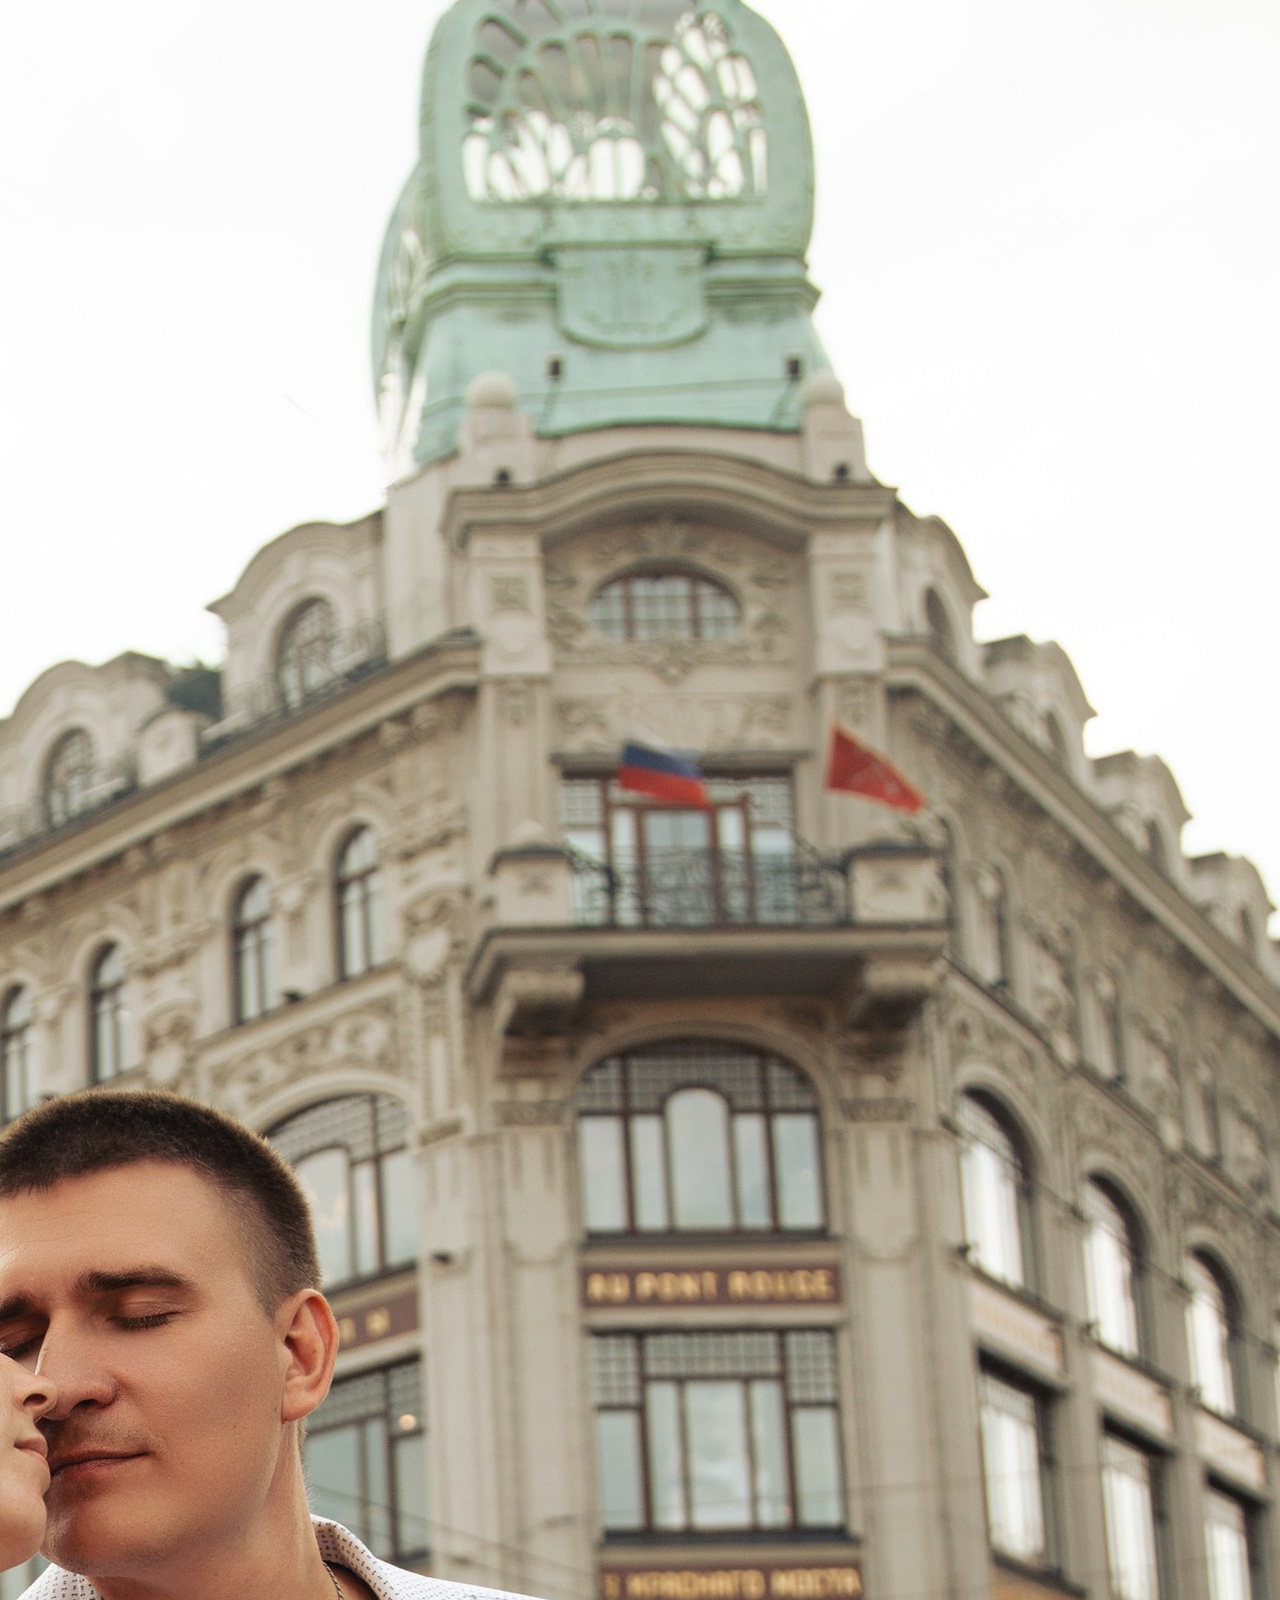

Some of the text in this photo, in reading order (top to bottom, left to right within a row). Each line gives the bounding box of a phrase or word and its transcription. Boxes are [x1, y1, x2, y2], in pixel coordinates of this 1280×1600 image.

[587, 1269, 836, 1303] AU PONT ROUGE
